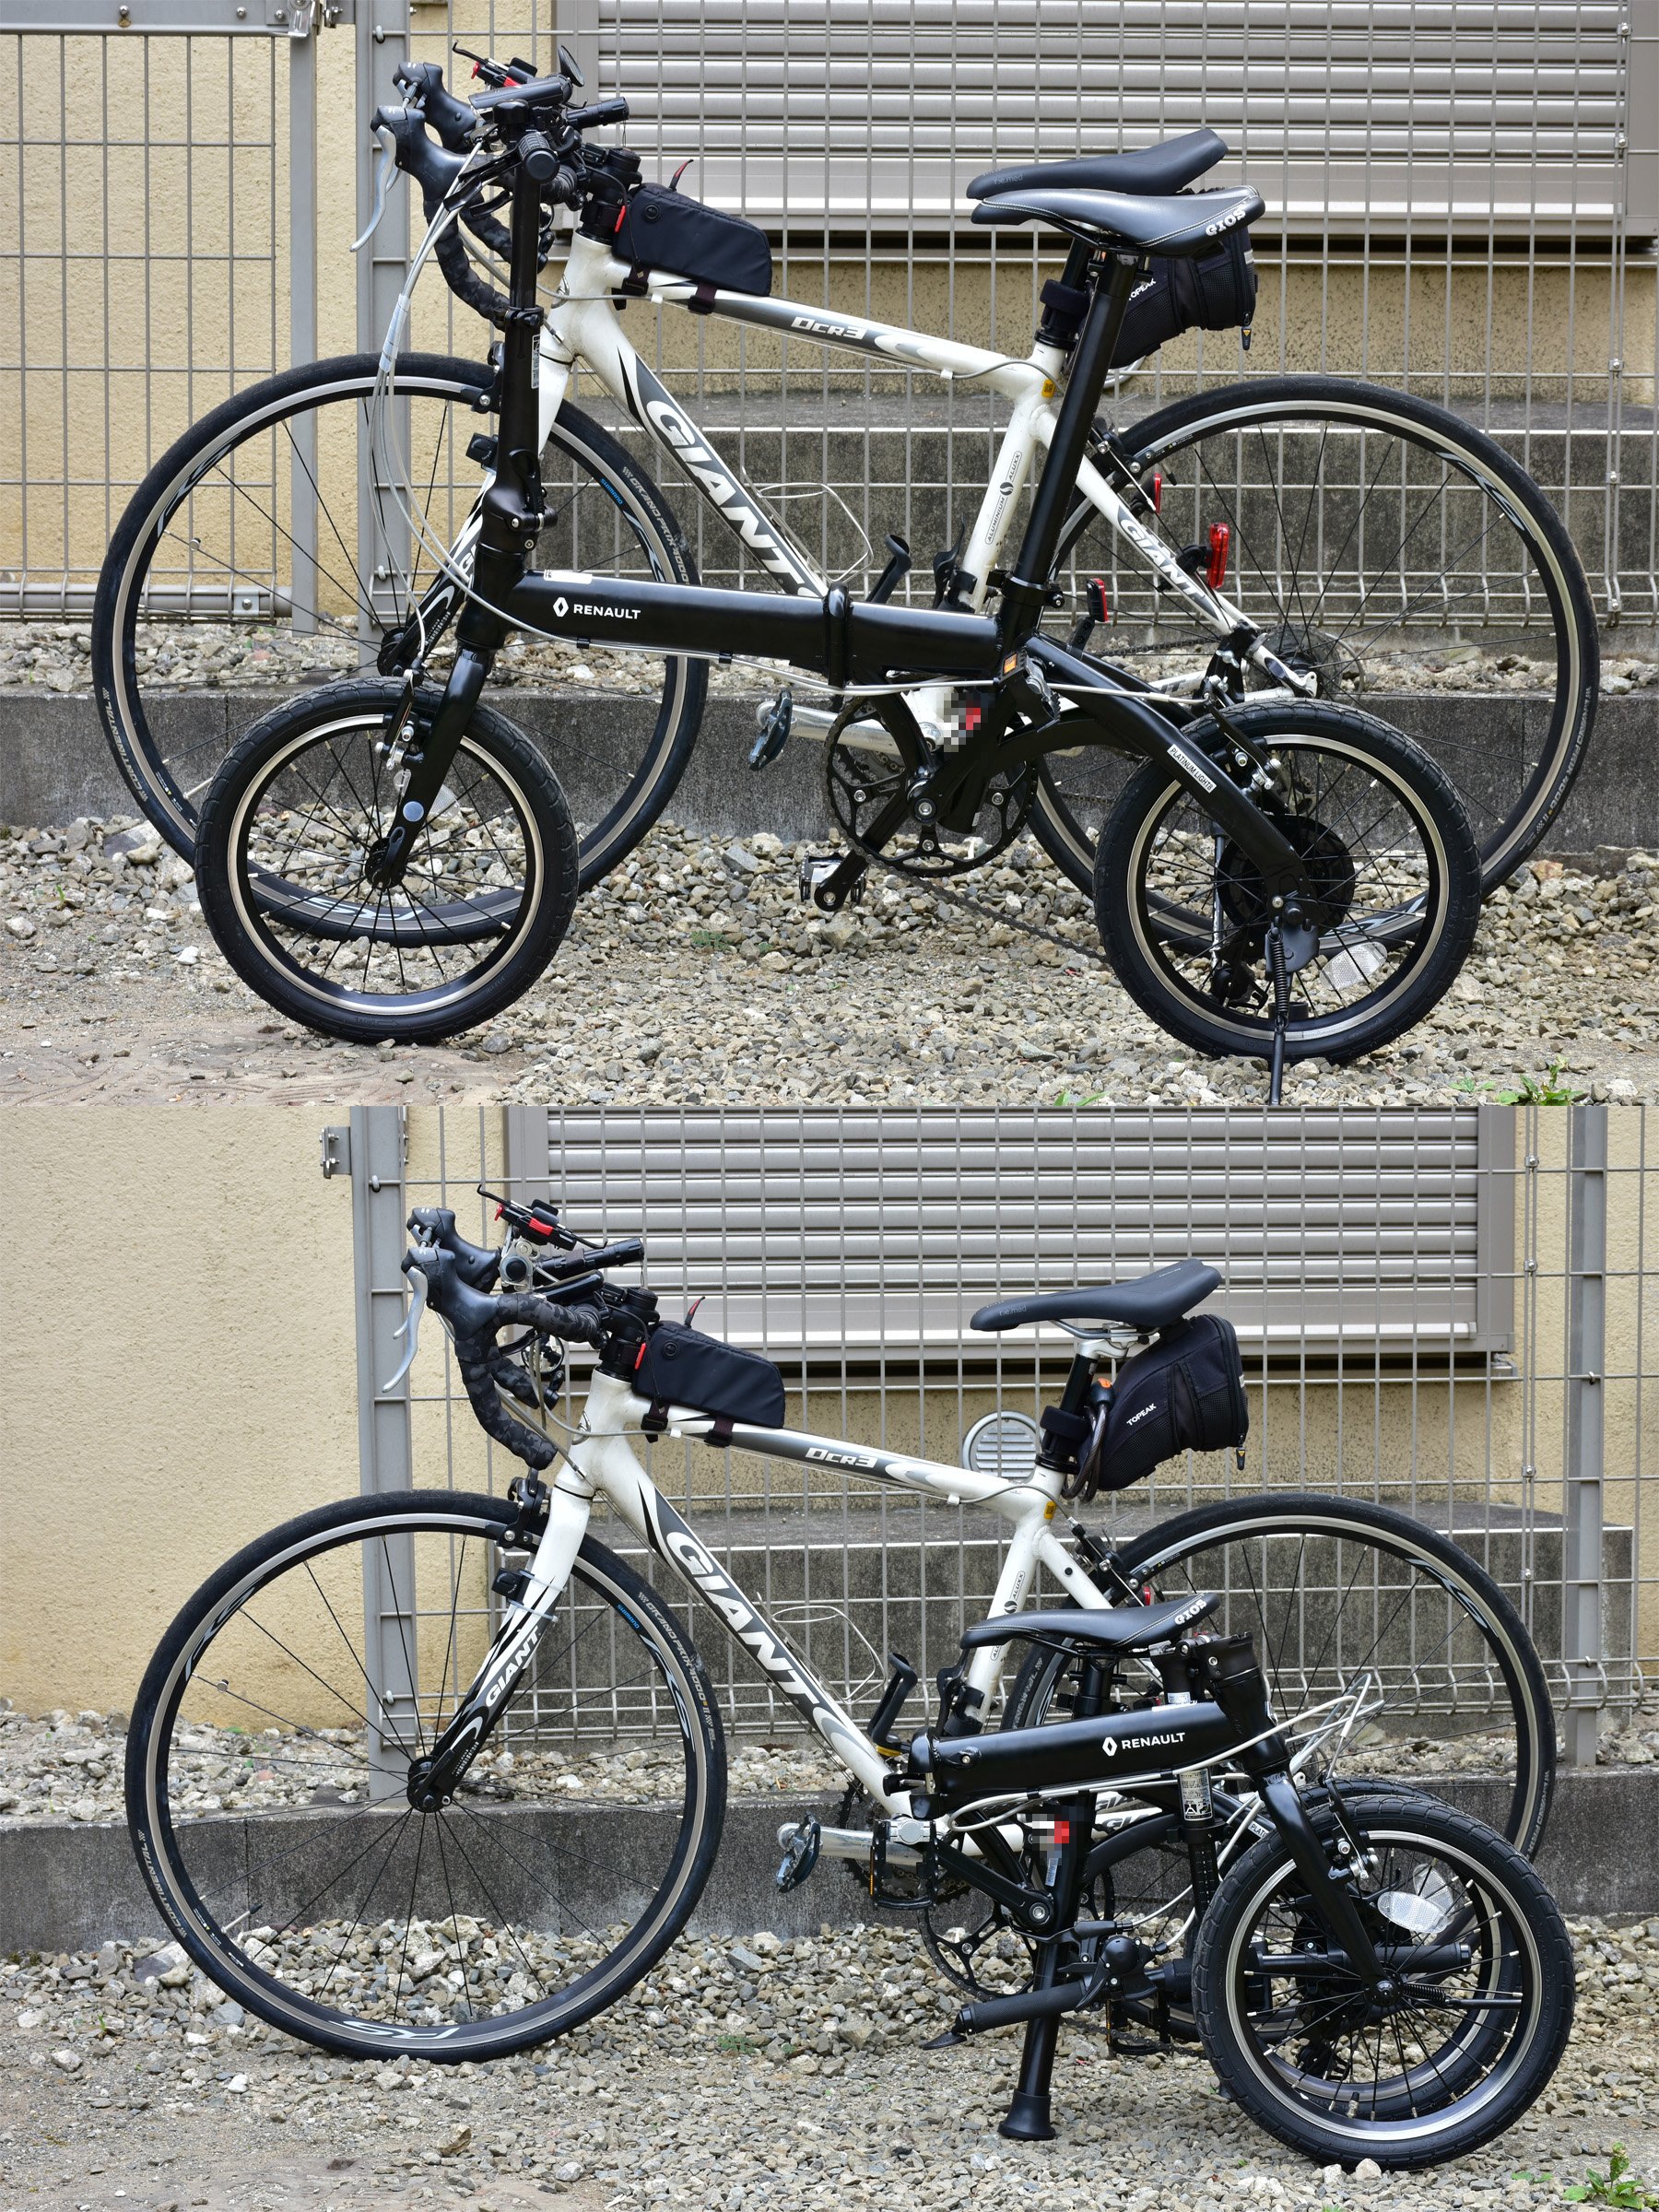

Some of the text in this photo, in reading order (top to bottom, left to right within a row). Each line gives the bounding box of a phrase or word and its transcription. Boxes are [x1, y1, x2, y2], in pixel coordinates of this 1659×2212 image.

[1206, 206, 1246, 237] GIOS
[1128, 277, 1157, 301] OPEAK
[791, 316, 868, 340] OCR3
[1008, 453, 1020, 480] ALUXX
[600, 478, 623, 505] SHIMANO
[646, 400, 806, 584] GIANT
[629, 477, 662, 517] GRAND
[657, 516, 677, 547] PRIX
[987, 497, 1006, 542] ALUMINIUM
[1120, 519, 1206, 599] GIANT
[573, 604, 641, 619] RENAULT
[1170, 747, 1196, 774] PLATINUM
[1126, 1403, 1157, 1426] TOPEAK
[805, 1447, 878, 1468] OCR3
[1012, 1573, 1023, 1600] ALUXX
[616, 1604, 641, 1630] SHIMANO
[666, 1532, 820, 1704] GIANT
[1174, 1599, 1207, 1625] GIOS
[646, 1602, 677, 1640] GRAND
[672, 1640, 692, 1667] PRIX
[486, 1625, 538, 1708] GIANT
[1121, 1732, 1185, 1750] RENAULT
